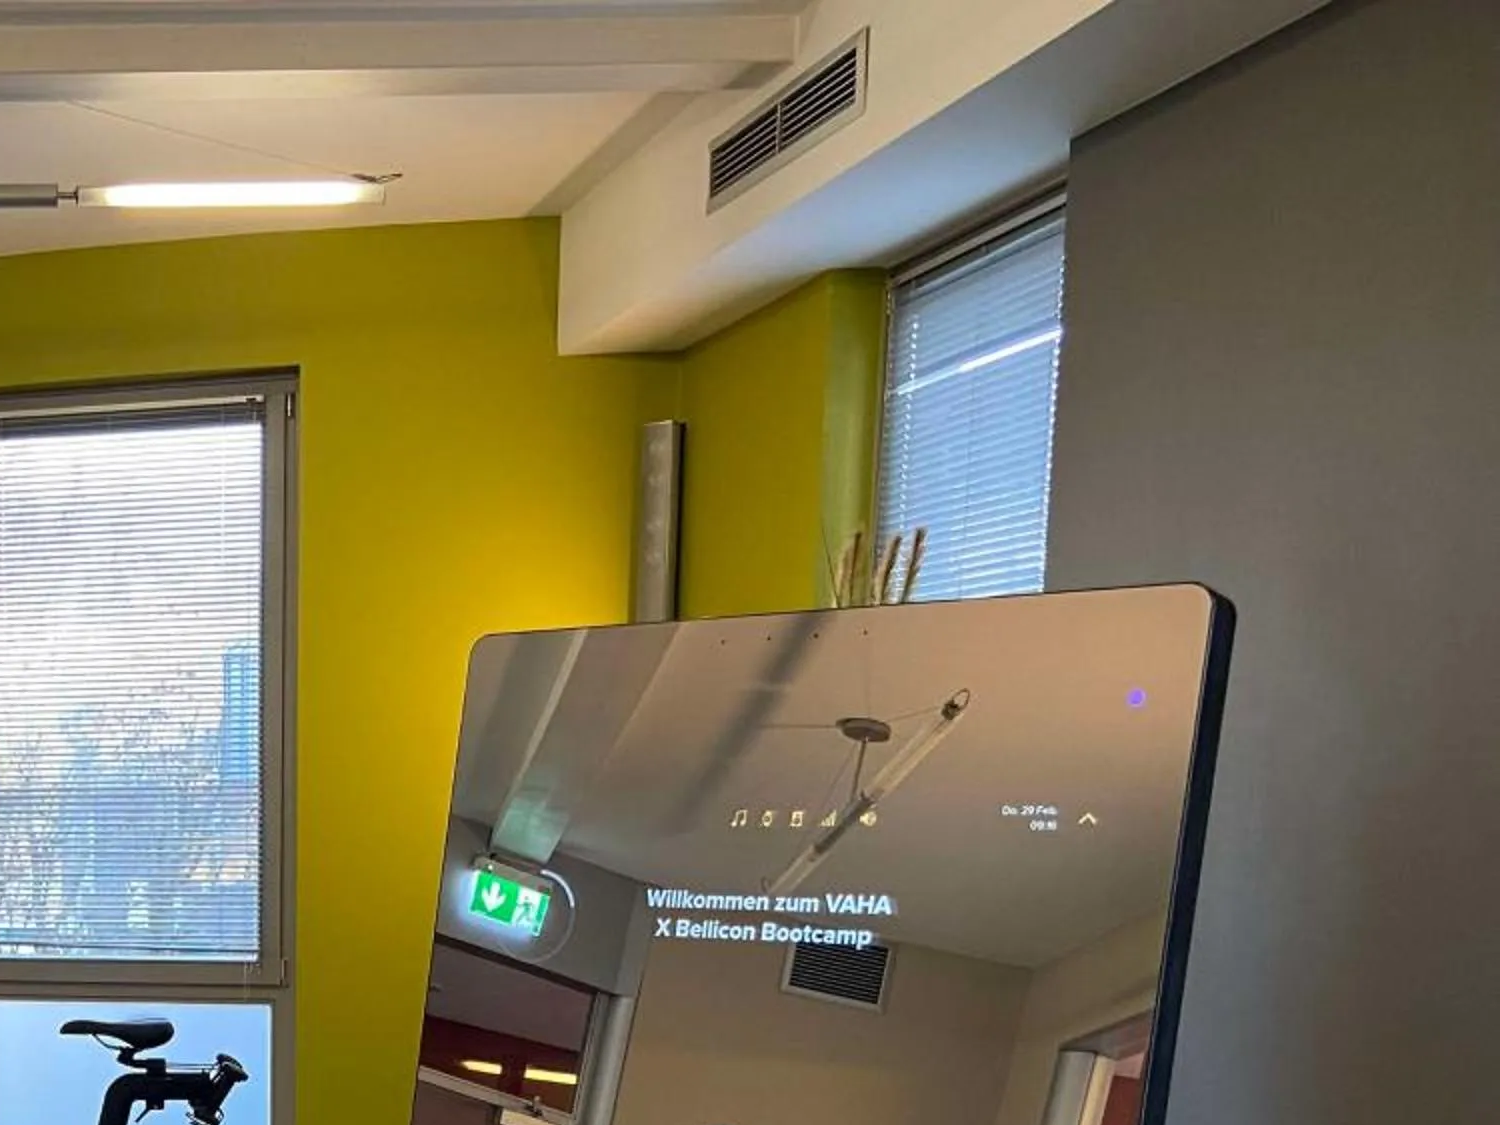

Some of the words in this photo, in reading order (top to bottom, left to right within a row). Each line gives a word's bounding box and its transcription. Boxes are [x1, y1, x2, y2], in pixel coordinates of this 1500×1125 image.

[647, 888, 769, 911] Willkommen
[774, 896, 820, 912] zum
[825, 893, 892, 915] VAHA
[654, 917, 672, 937] X
[675, 919, 756, 940] Bellicon
[761, 921, 873, 950] Bootcamp
